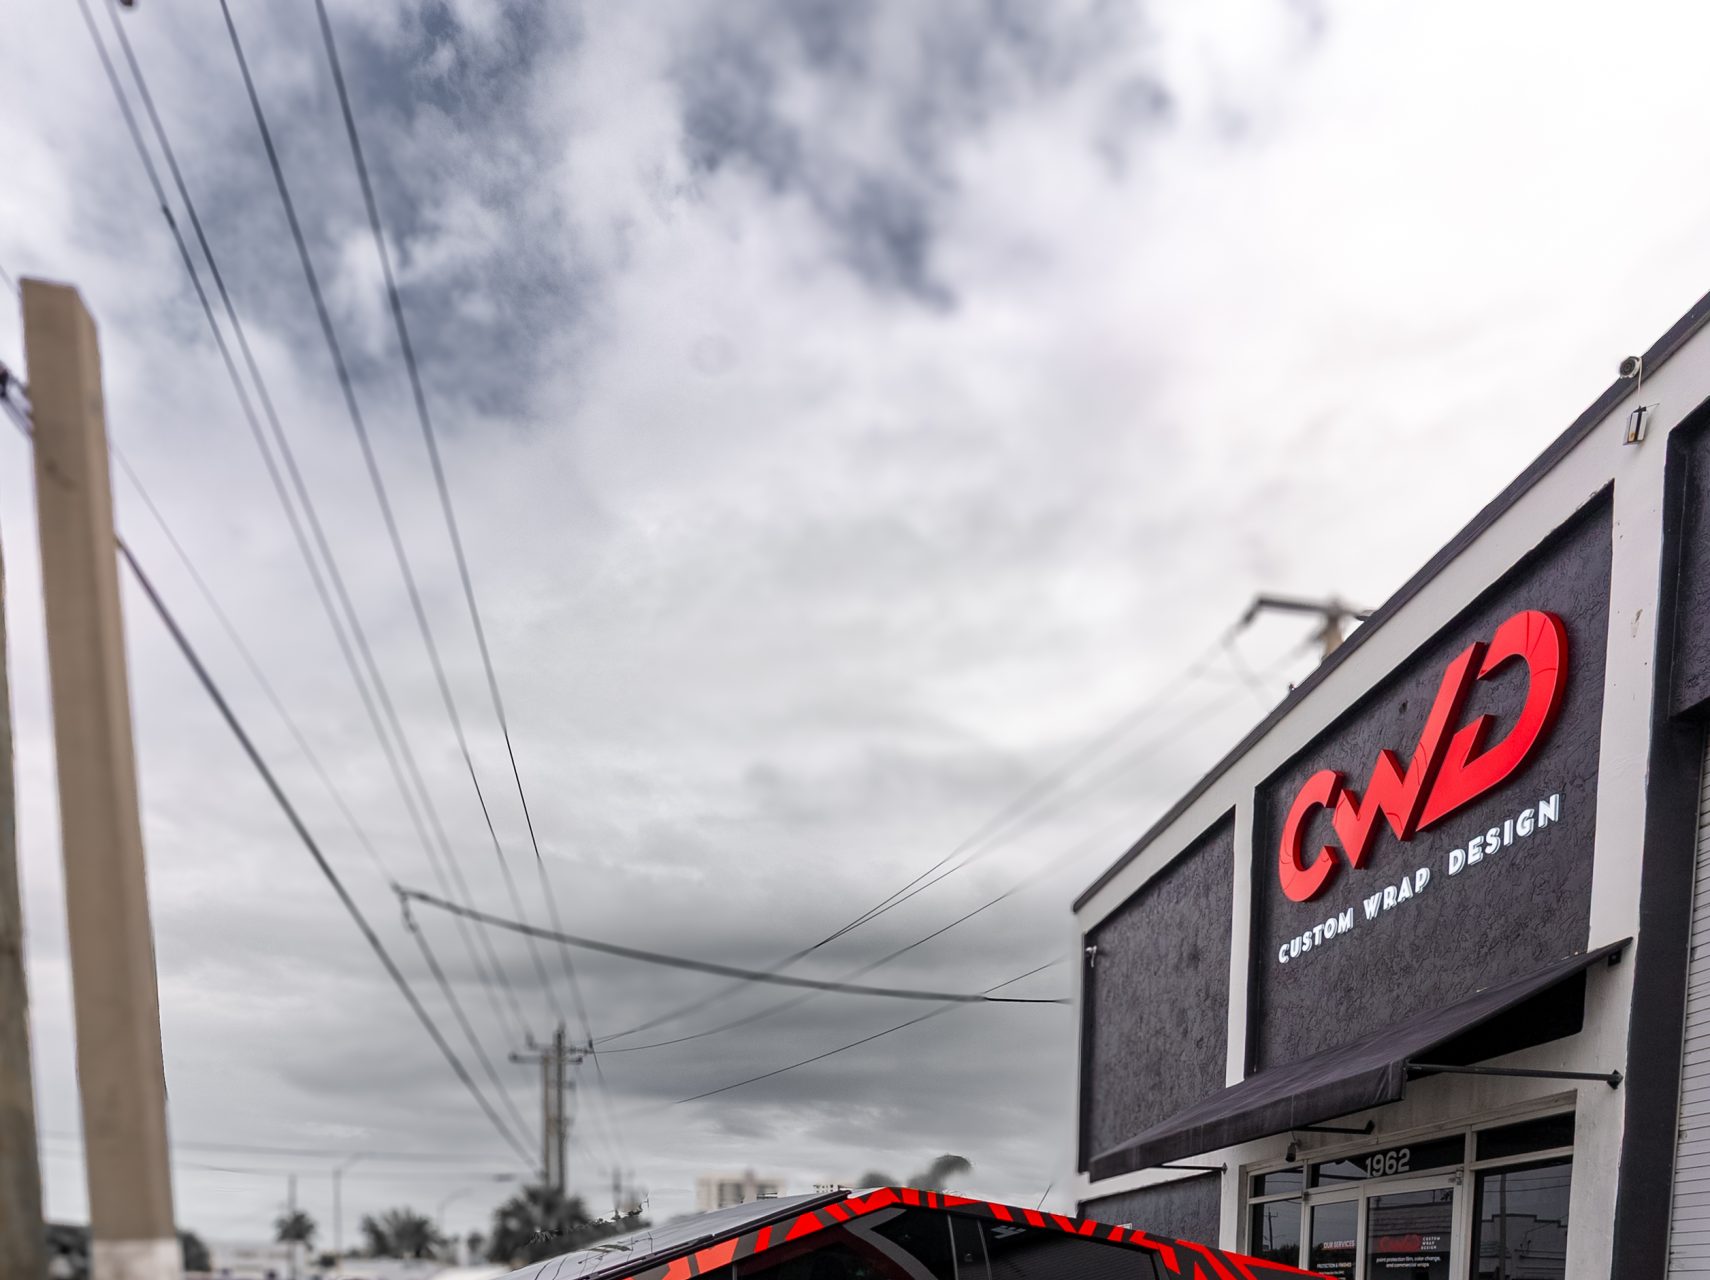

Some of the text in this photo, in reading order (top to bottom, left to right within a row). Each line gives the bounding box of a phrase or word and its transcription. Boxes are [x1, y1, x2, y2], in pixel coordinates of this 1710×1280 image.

[1278, 610, 1568, 902] CWD
[1278, 794, 1560, 963] CUSTOM WRAP DESIGN
[1365, 1148, 1410, 1178] 1962
[1333, 1240, 1355, 1248] SERVICES
